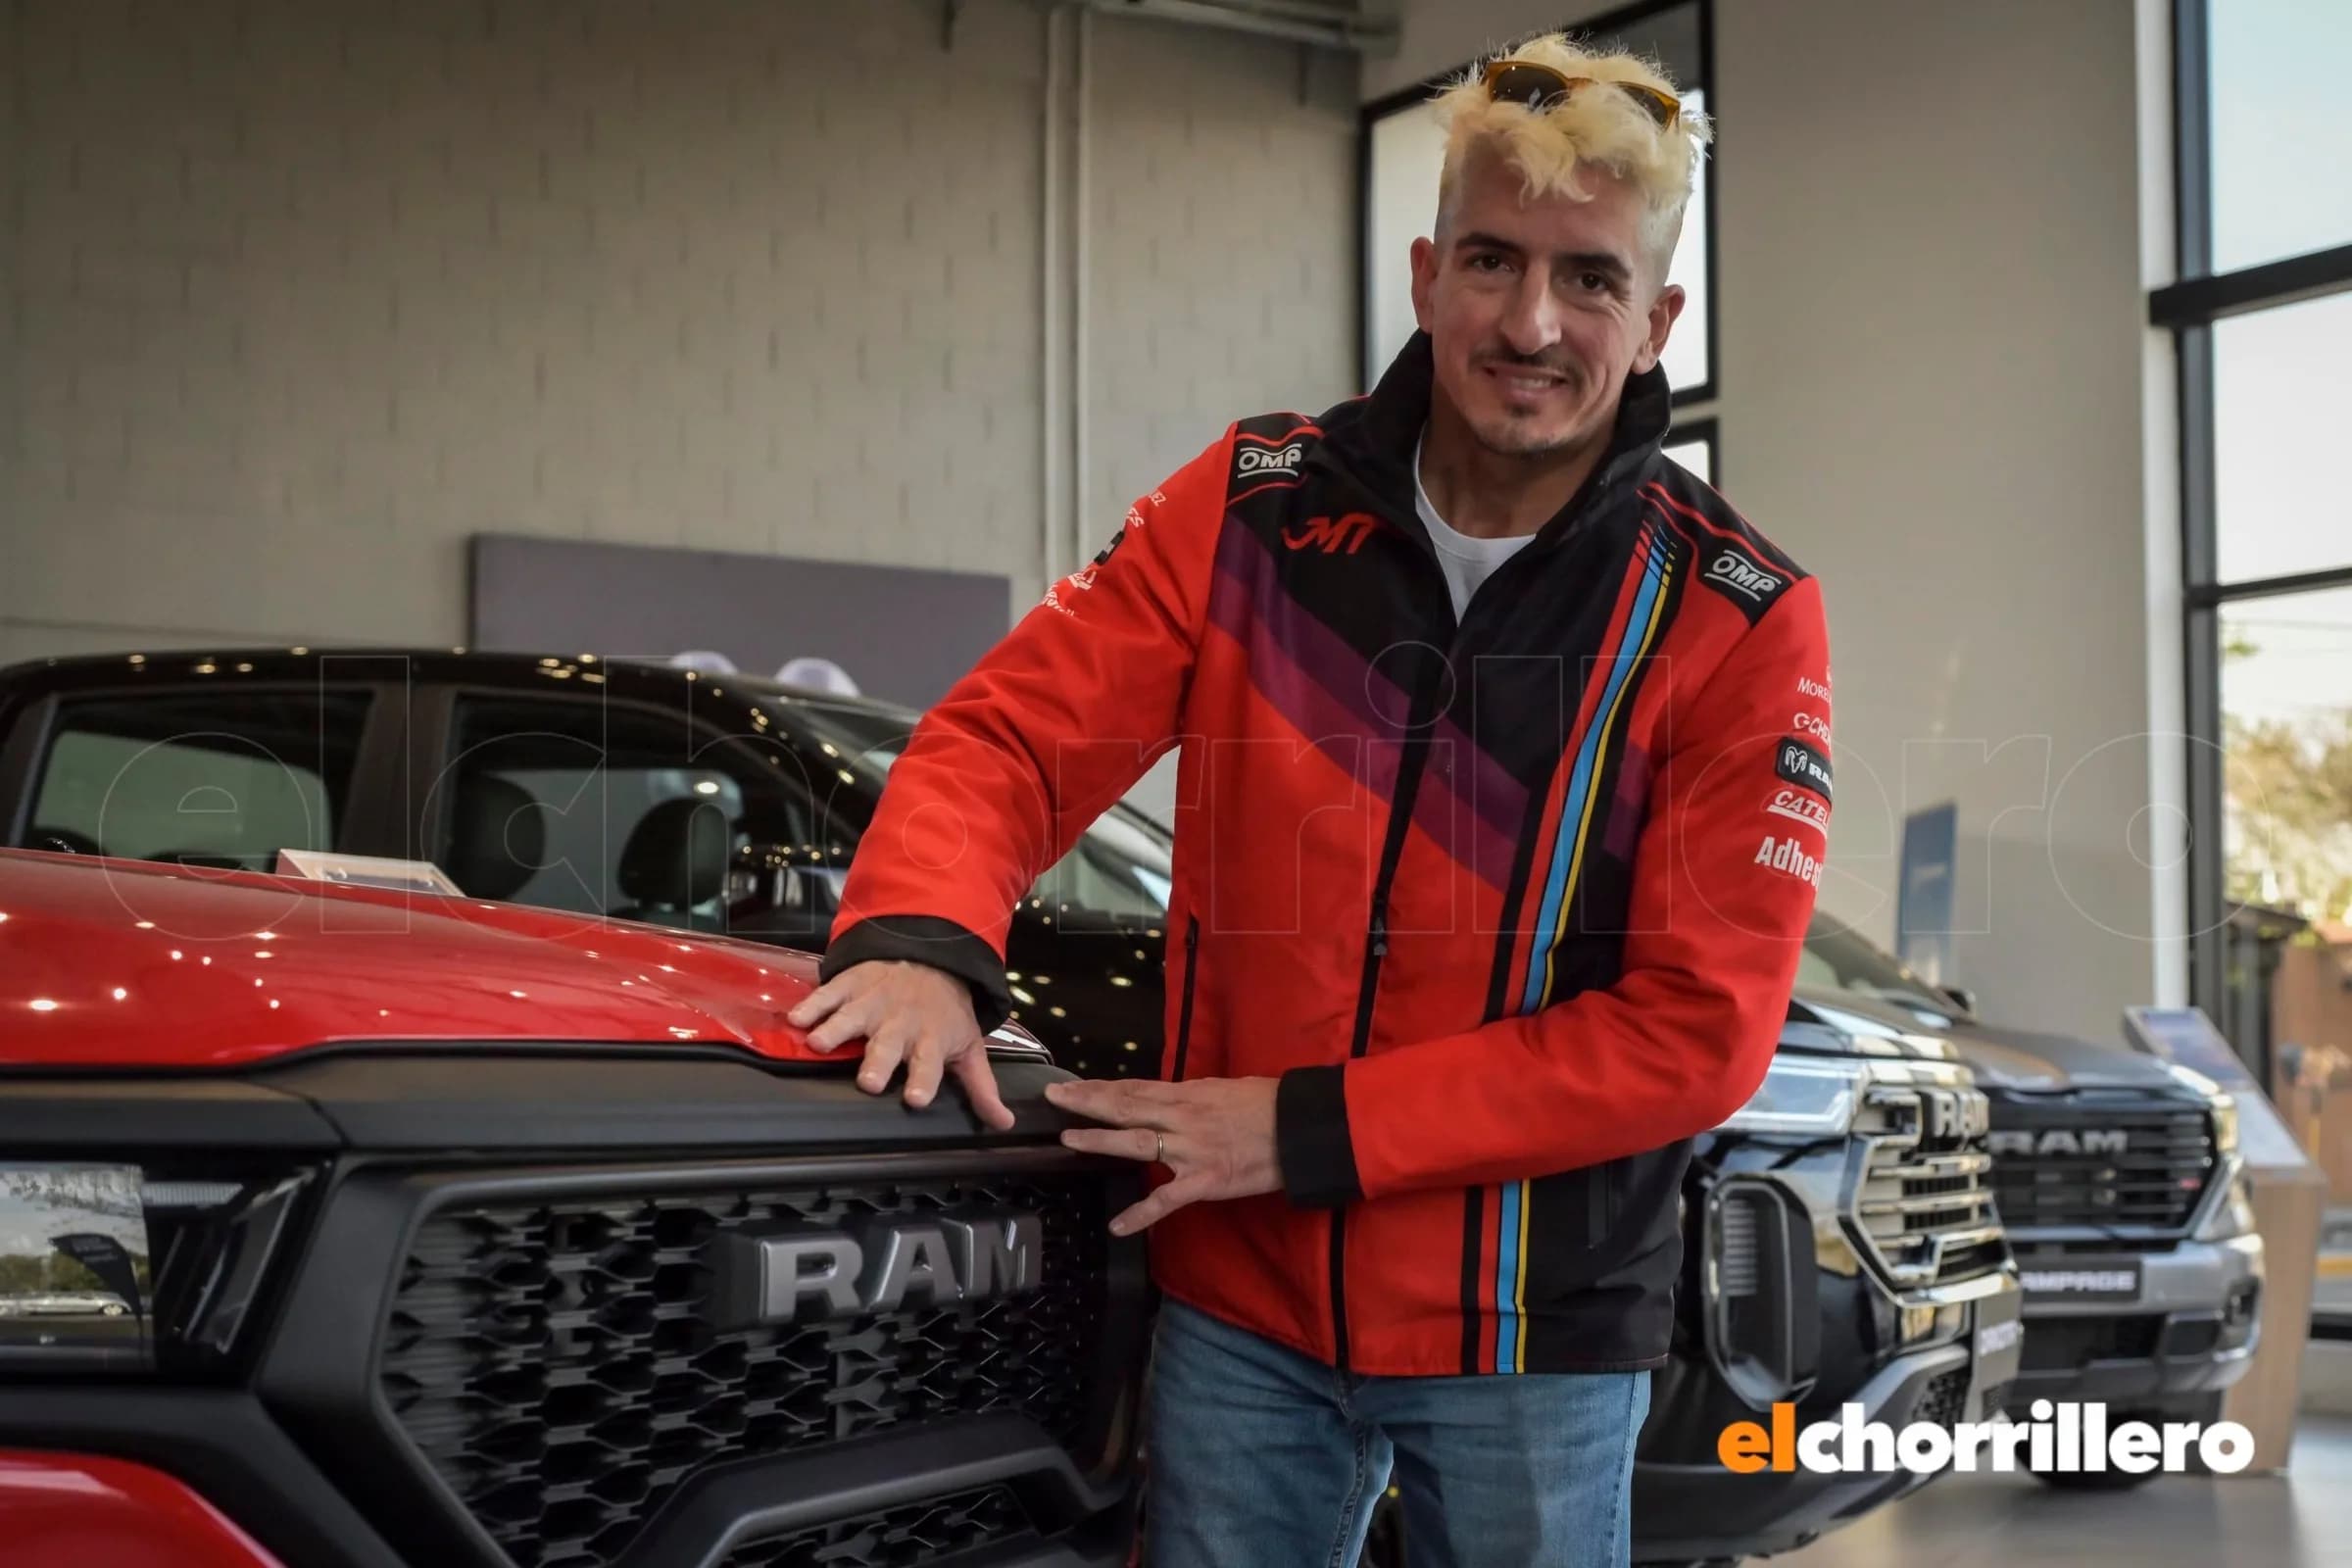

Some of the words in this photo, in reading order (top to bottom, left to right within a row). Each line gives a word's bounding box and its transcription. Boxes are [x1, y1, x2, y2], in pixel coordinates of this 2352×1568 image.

[1238, 448, 1302, 471] OMP
[1712, 556, 1777, 592] OMP
[1808, 762, 1833, 794] RA
[1988, 1130, 2129, 1153] RAM
[759, 1218, 1043, 1319] RAM
[2020, 1270, 2135, 1292] AMPAGE
